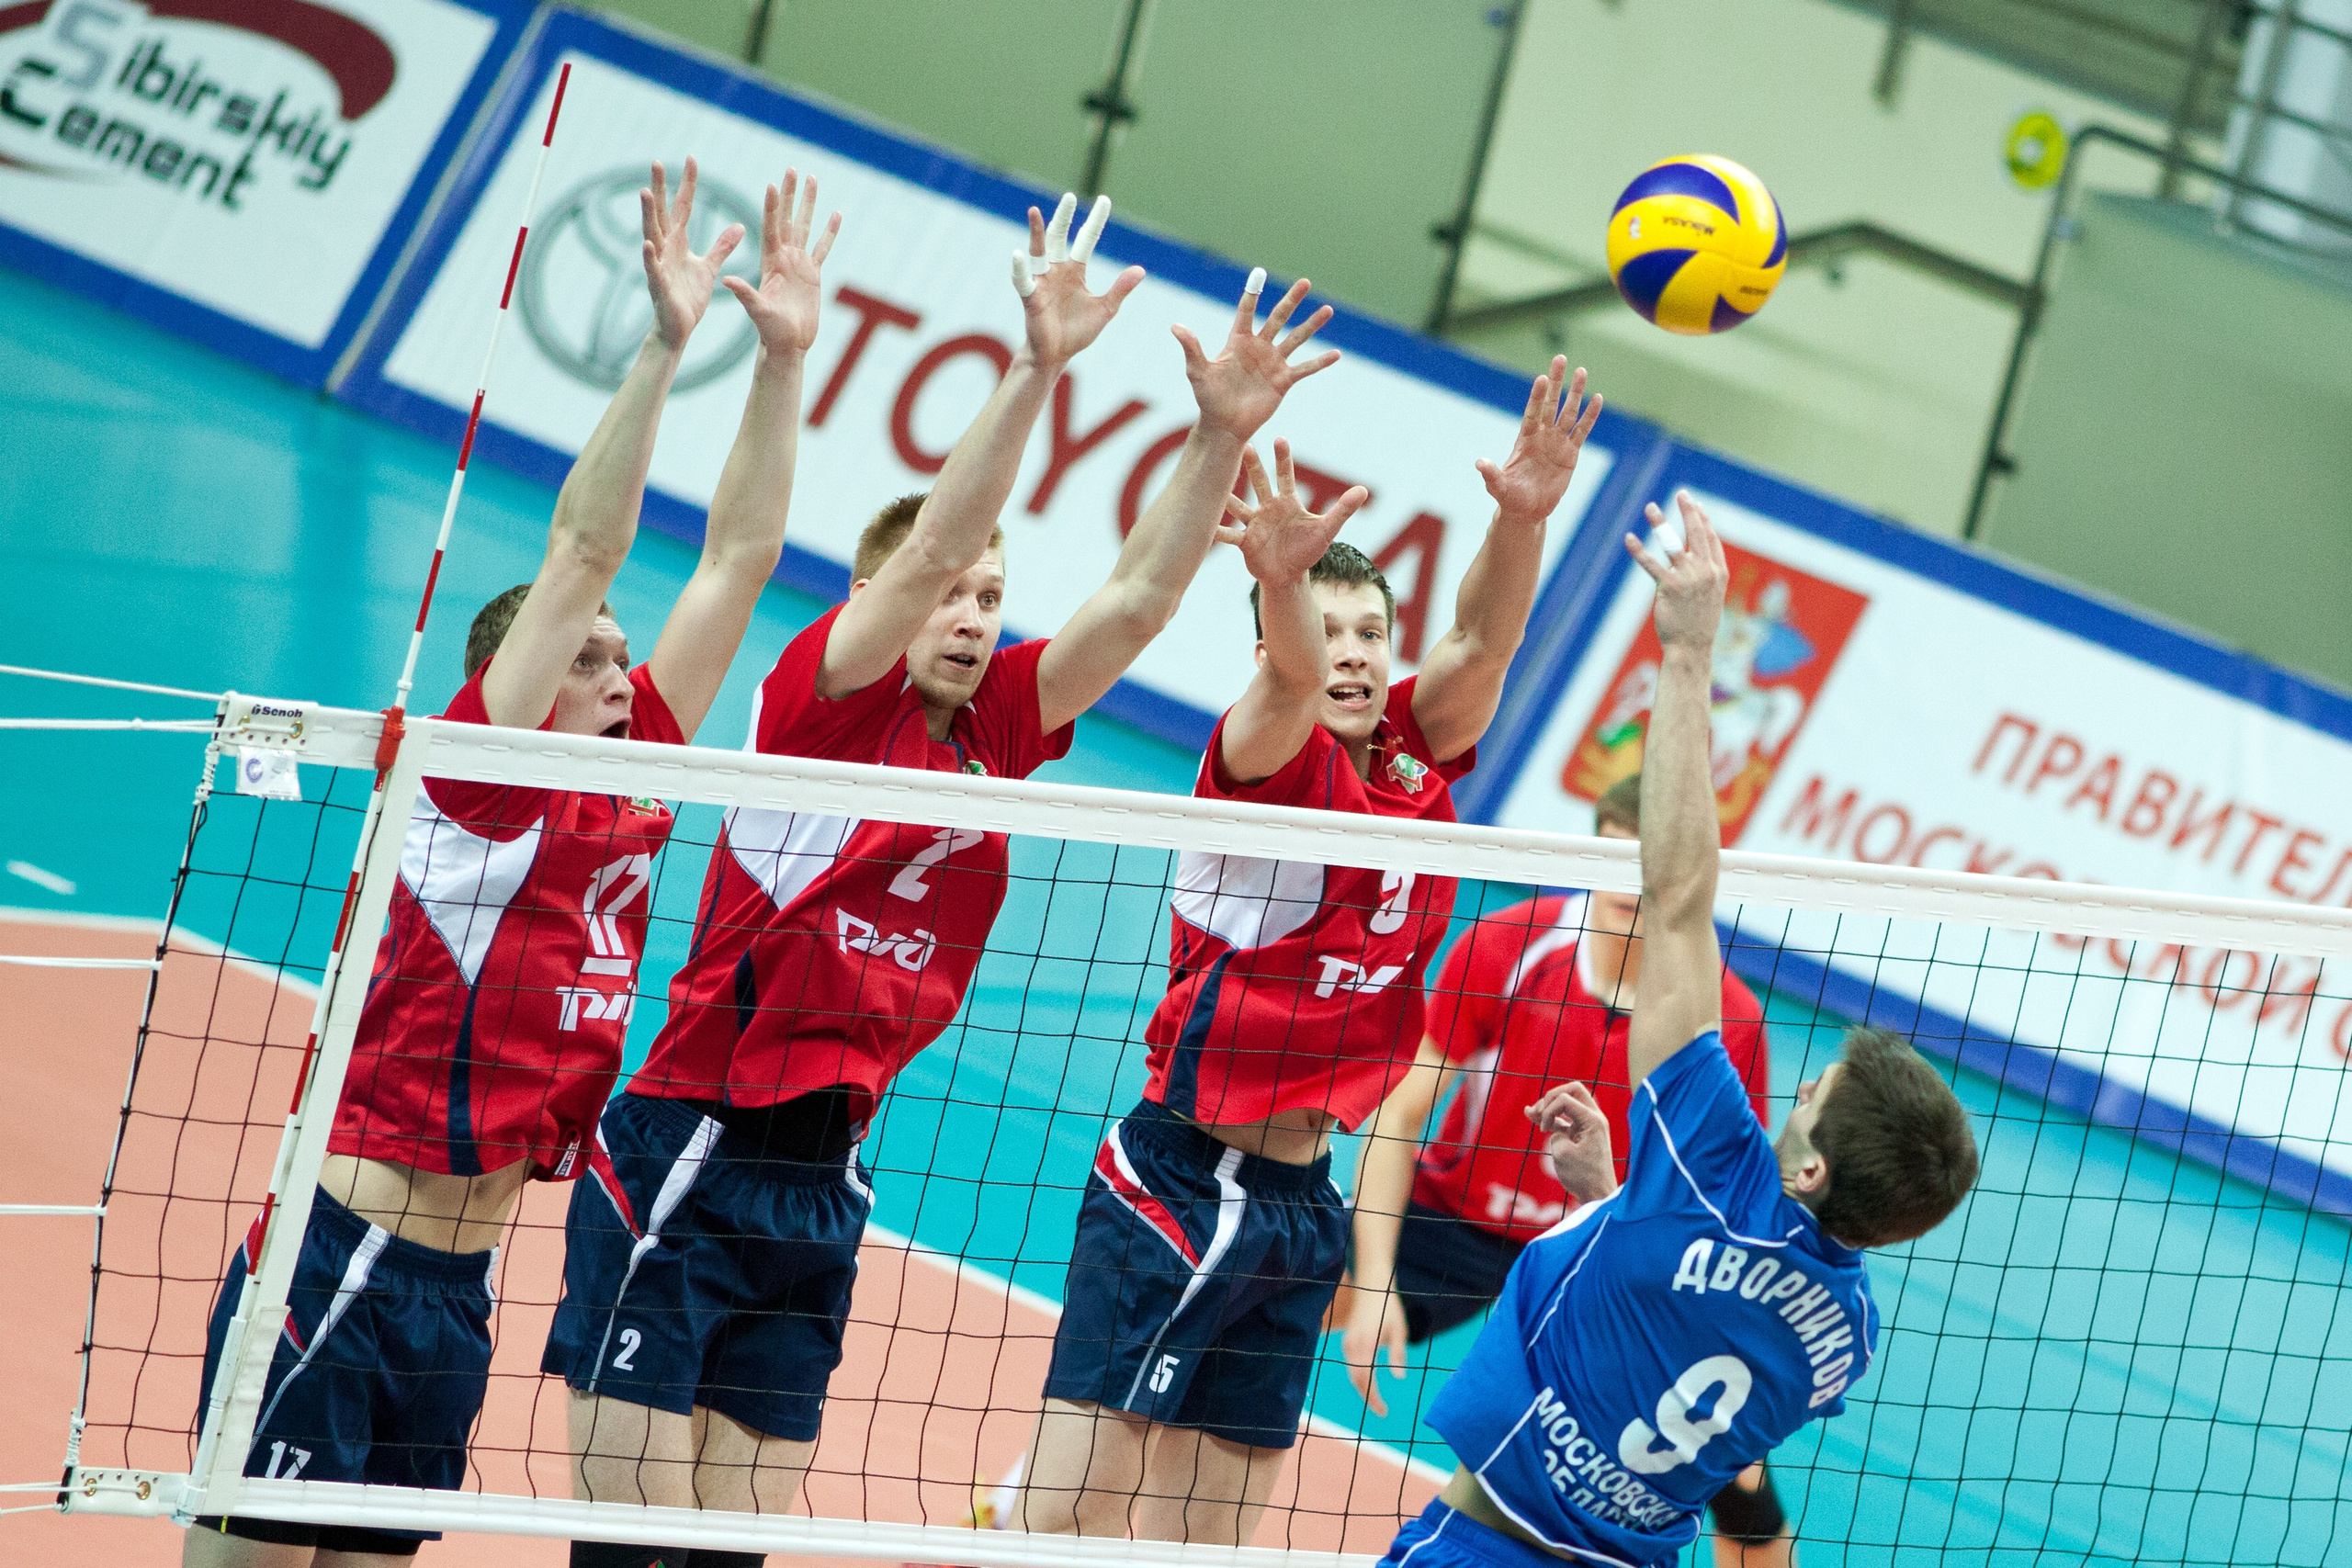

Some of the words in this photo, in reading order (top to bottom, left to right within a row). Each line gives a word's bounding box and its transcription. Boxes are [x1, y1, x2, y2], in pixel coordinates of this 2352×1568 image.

[0, 57, 260, 212] Cement
[53, 2, 355, 191] Sibirskiy
[888, 828, 985, 903] 2
[613, 1328, 642, 1371] 2
[1671, 1237, 1854, 1409] ДВОРНИКОВ
[1148, 1354, 1181, 1393] 5
[1618, 1354, 1753, 1475] 9
[265, 1440, 312, 1480] 17
